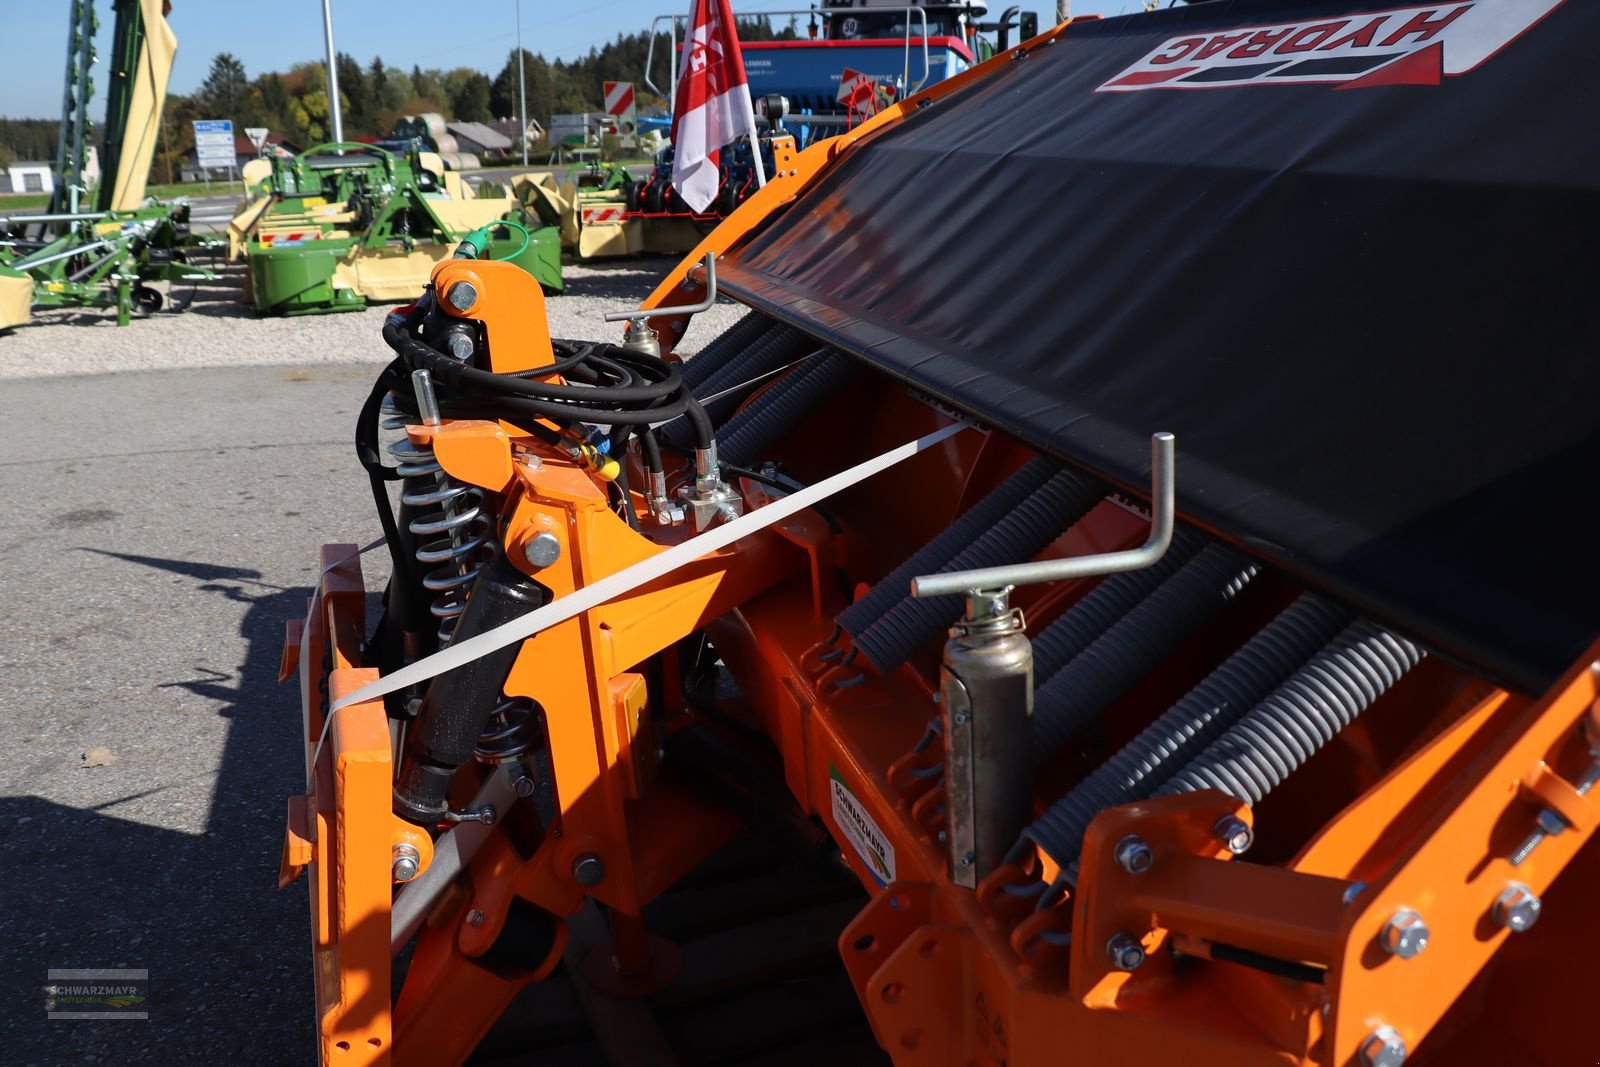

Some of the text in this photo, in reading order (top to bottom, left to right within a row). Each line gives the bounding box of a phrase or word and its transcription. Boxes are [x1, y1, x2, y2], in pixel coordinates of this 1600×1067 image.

[844, 20, 856, 33] 50
[1149, 3, 1476, 65] HYDRAC
[834, 782, 886, 861] SCHWARZMAYR
